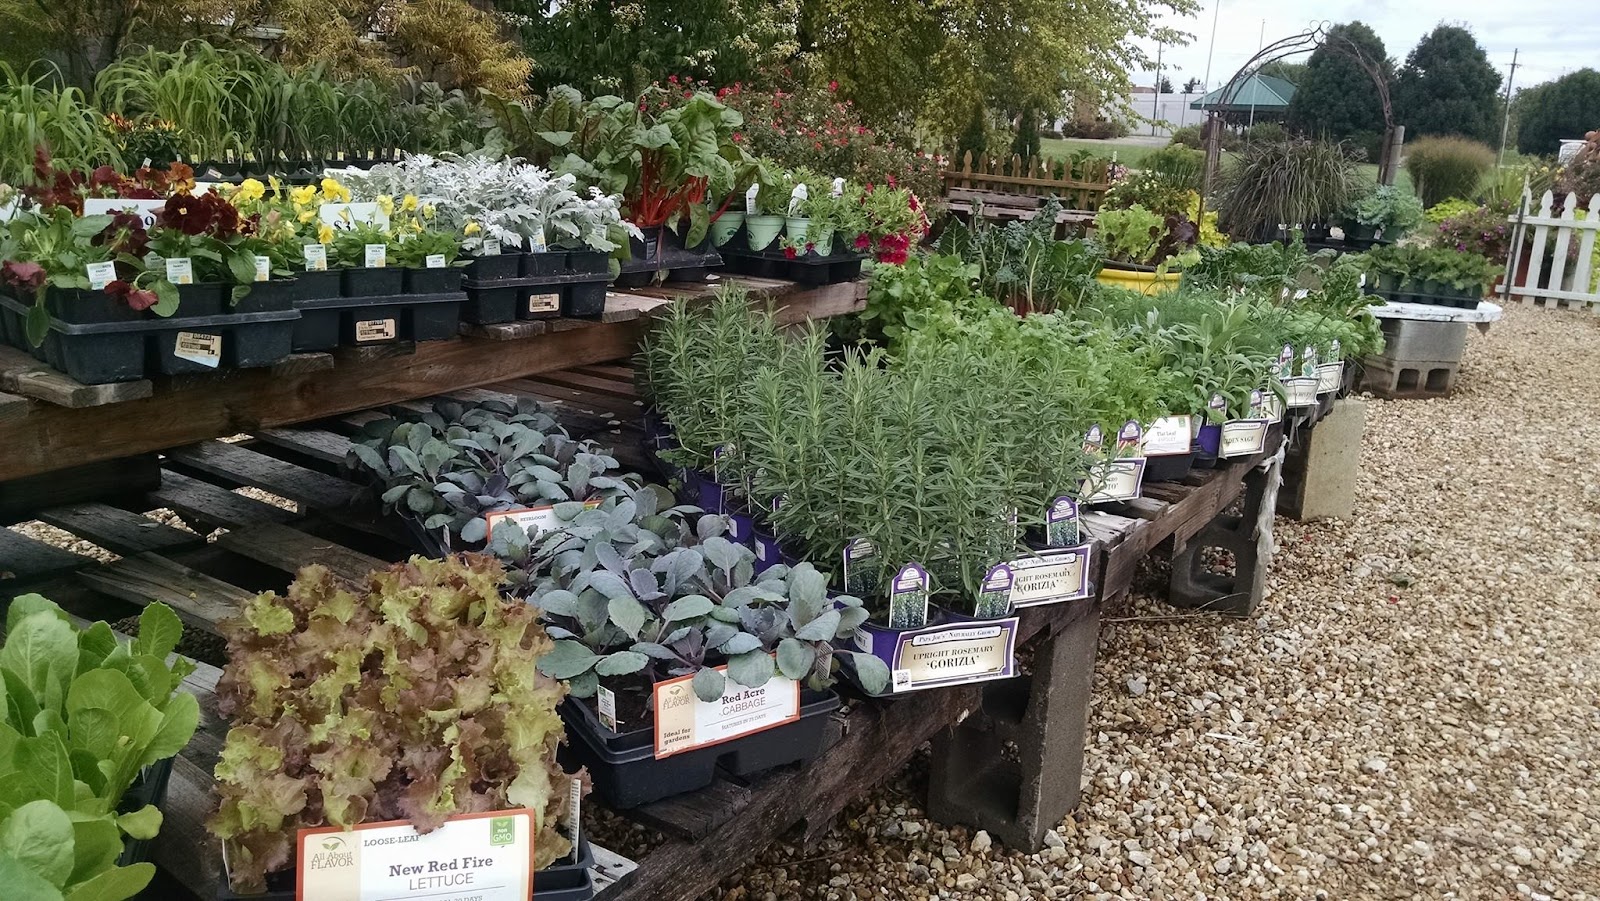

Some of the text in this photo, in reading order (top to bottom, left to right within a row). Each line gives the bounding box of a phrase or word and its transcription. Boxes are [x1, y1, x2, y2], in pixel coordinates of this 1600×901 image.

[913, 645, 995, 661] UPRIGHT ROSEMARY
[721, 688, 766, 705] Red Acre
[722, 696, 766, 716] CABBAGE
[664, 727, 691, 739] Ideal for
[664, 734, 691, 746] gardens
[493, 832, 512, 843] GMO
[310, 857, 354, 870] FLAVOR
[312, 851, 353, 862] All About
[389, 856, 494, 878] New Red Fire
[409, 872, 475, 891] LETTUCE
